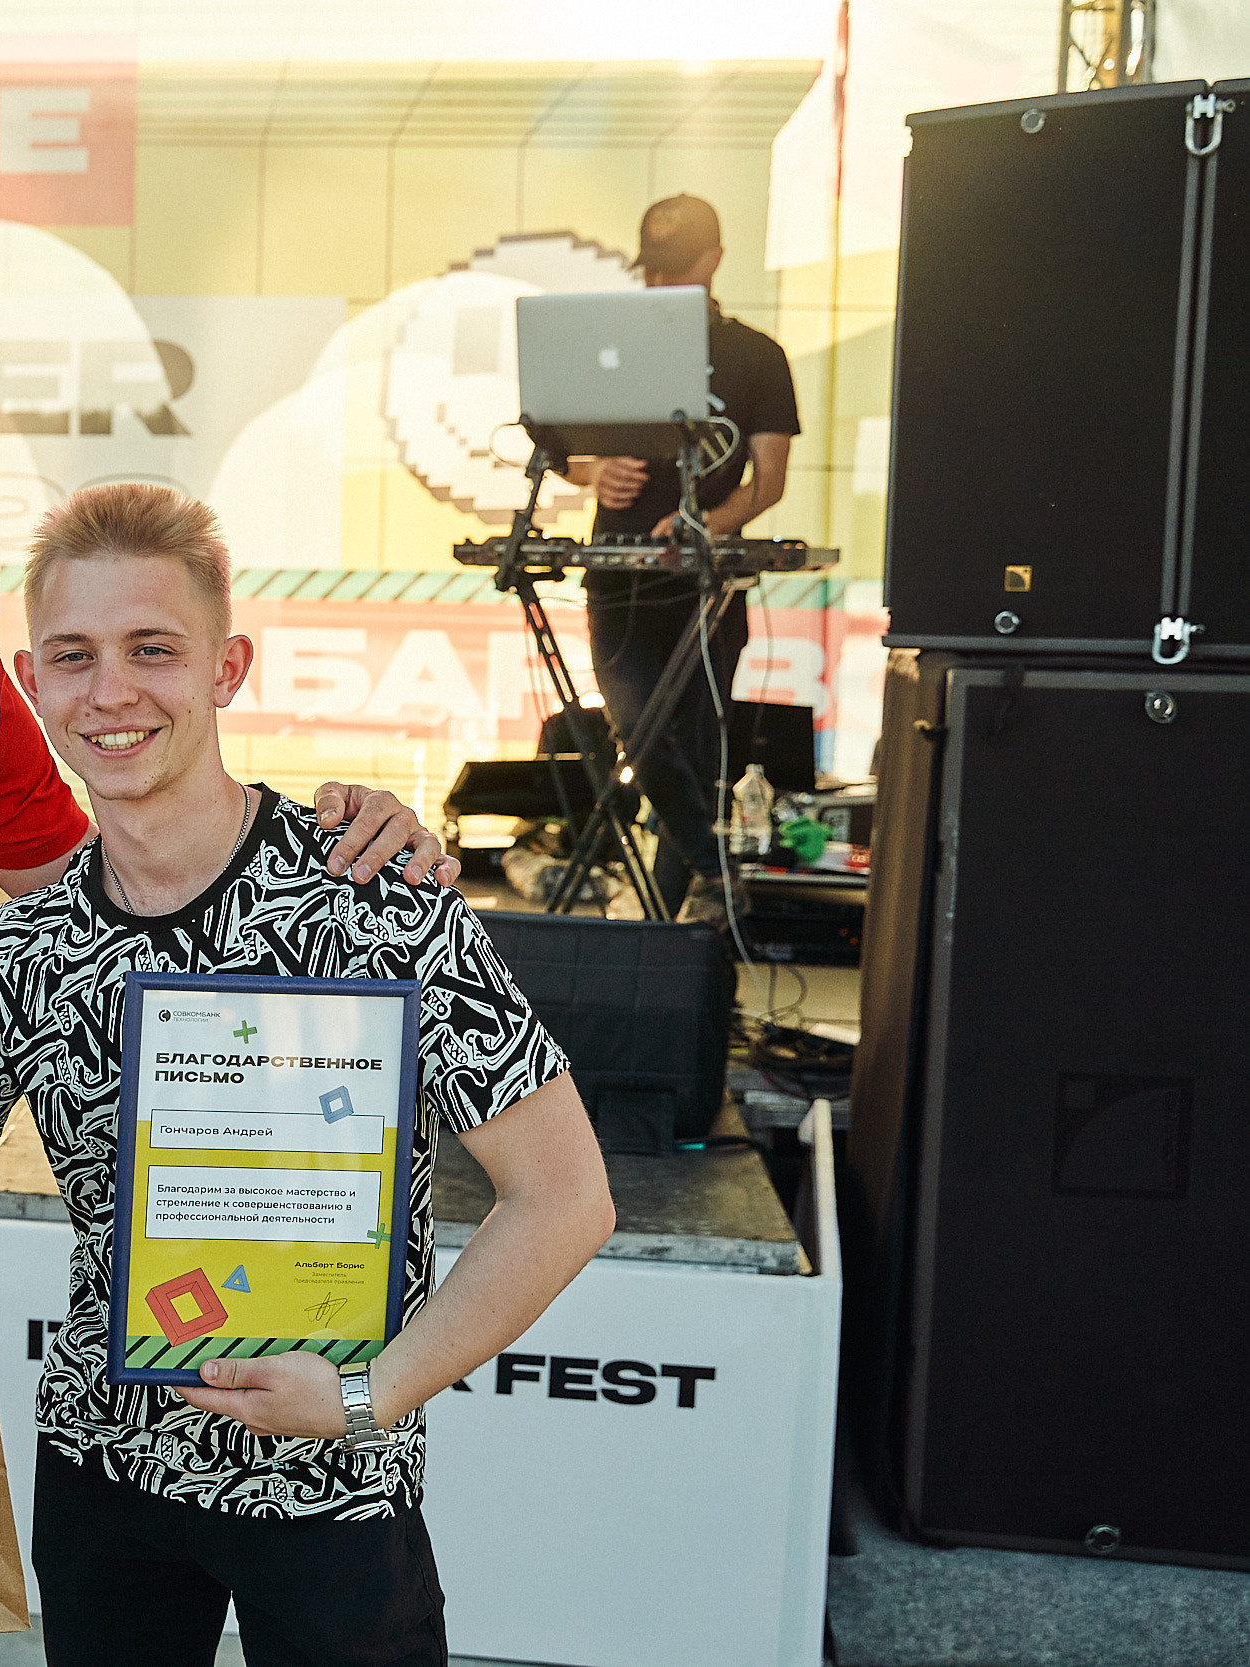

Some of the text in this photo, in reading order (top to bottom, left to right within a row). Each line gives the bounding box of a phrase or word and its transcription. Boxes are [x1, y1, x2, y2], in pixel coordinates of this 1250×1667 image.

[172, 1010, 221, 1018] СОВКОМБАНК
[155, 1052, 383, 1071] БЛАГОДАРСТВЕННОЕ
[154, 1070, 245, 1084] ПИСЬМО
[159, 1125, 273, 1138] Гончаров Андрей
[157, 1184, 222, 1195] Благодарим
[238, 1187, 283, 1195] высокое
[286, 1188, 347, 1198] мастерство
[349, 1190, 356, 1198] и
[156, 1199, 221, 1208] стремление
[232, 1201, 343, 1211] совершенствованию
[155, 1212, 335, 1224] профессиональной деятельности
[294, 1261, 365, 1270] Альберт Борис
[495, 1352, 716, 1408] FEST
